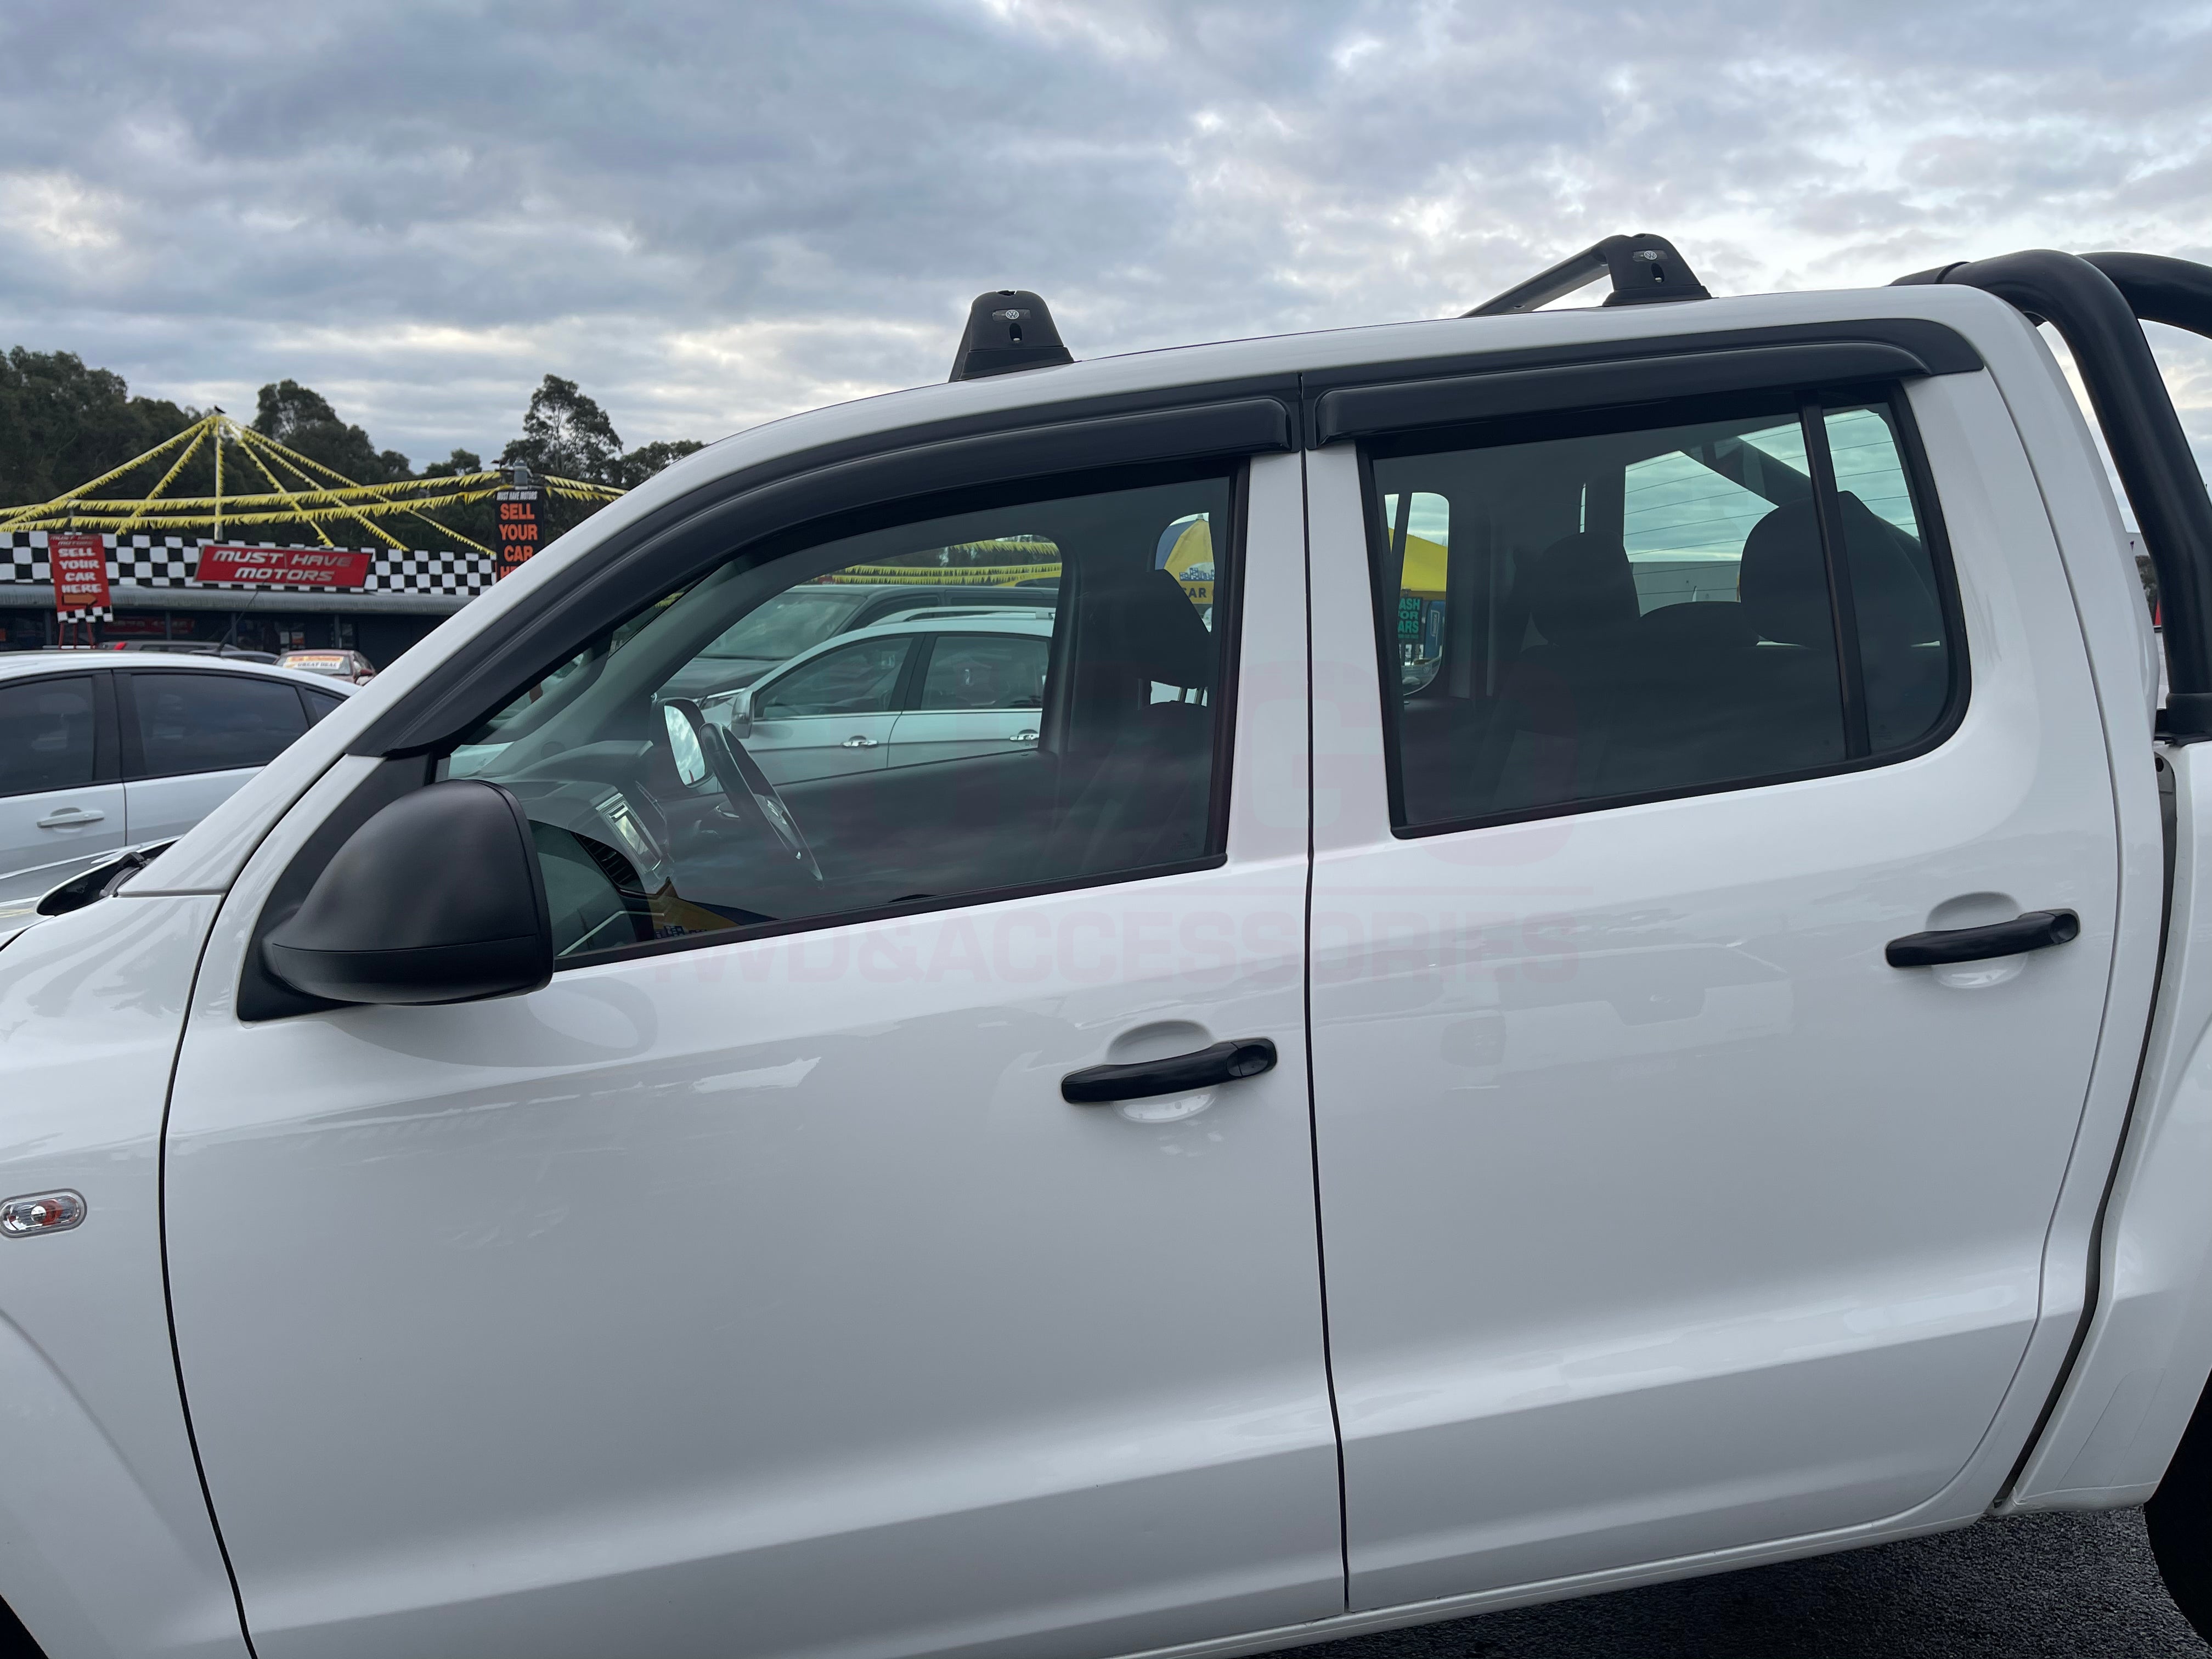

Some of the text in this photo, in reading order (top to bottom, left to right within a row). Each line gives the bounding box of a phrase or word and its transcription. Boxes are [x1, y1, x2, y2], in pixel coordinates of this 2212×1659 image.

[500, 503, 535, 520] SELL
[499, 524, 538, 540] YOUR
[58, 548, 96, 557] SELL
[213, 550, 354, 567] MUST HAVE
[504, 545, 534, 562] CAR
[59, 560, 100, 570] YOUR
[65, 572, 96, 582] CAR
[234, 567, 335, 582] MOTORS
[61, 584, 103, 593] HERE
[1183, 588, 1207, 598] AR
[1398, 598, 1420, 610] ASH
[1398, 611, 1419, 620] OR
[1397, 620, 1419, 633] ARS
